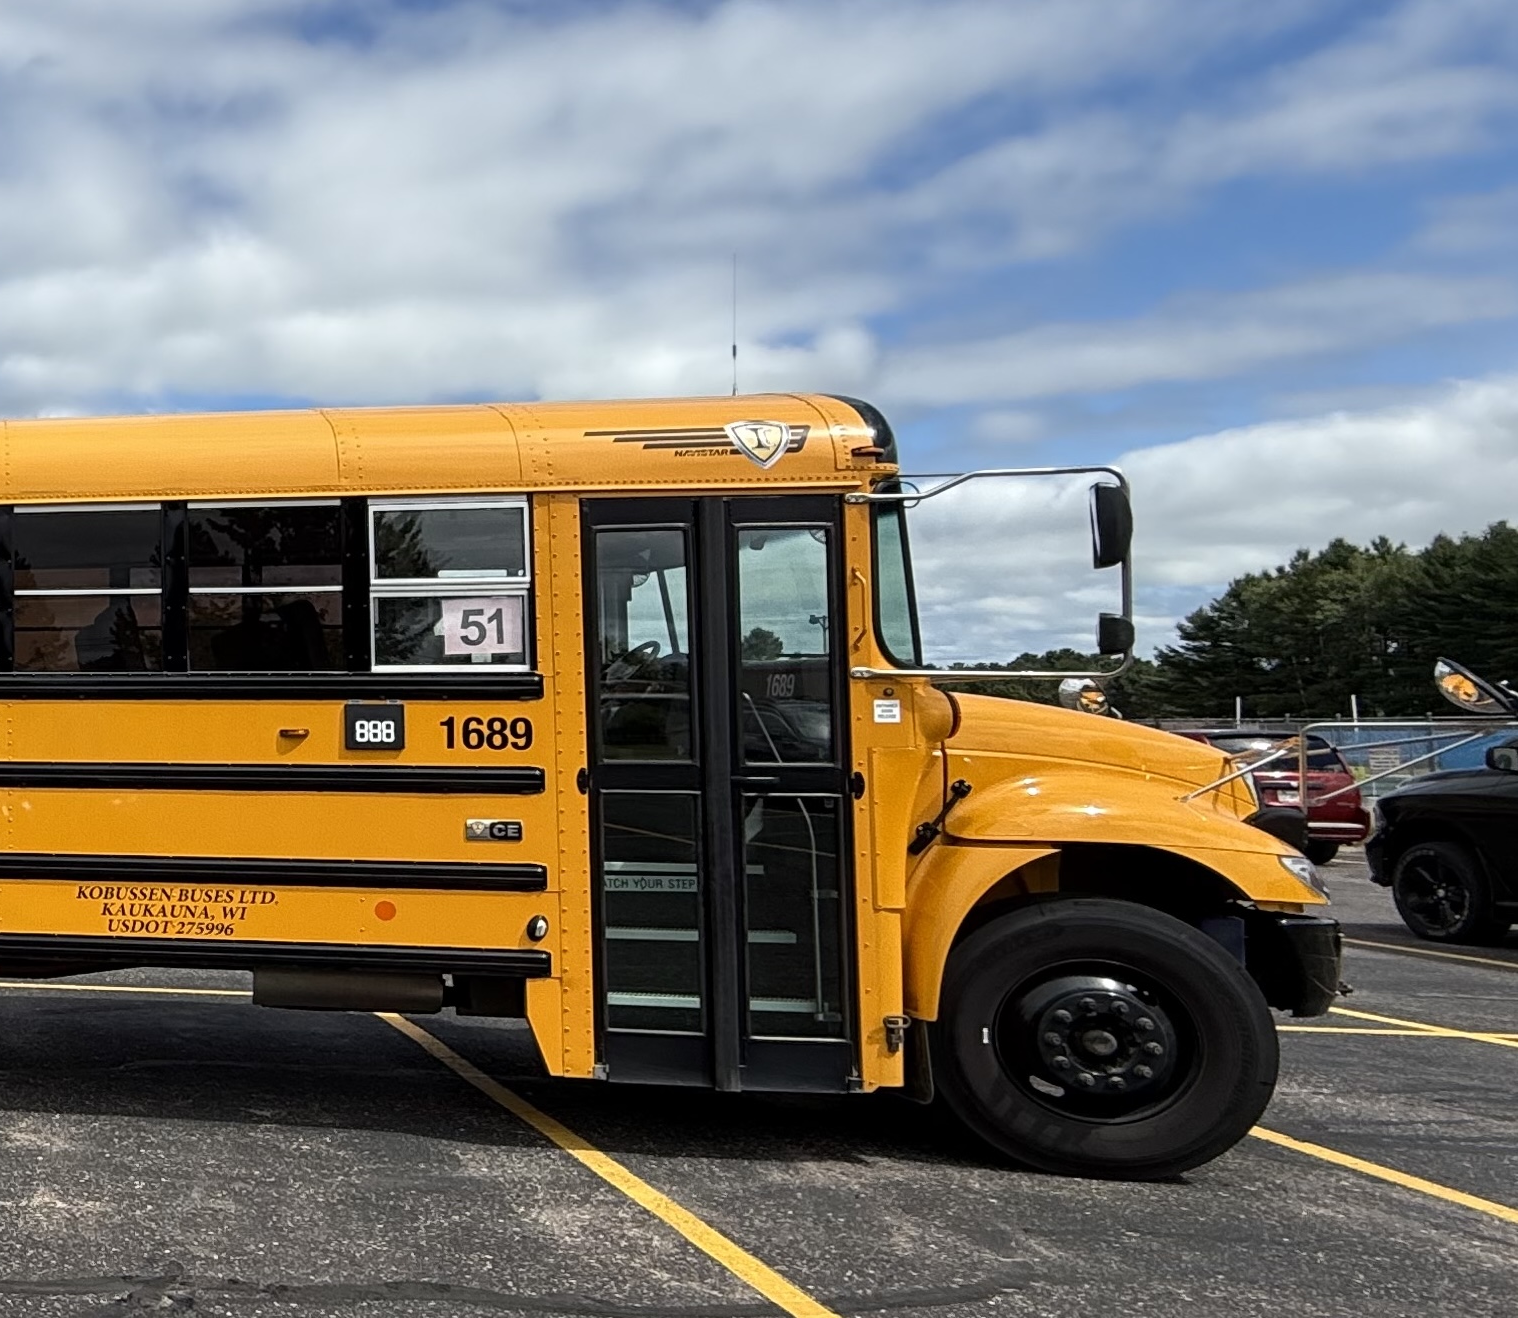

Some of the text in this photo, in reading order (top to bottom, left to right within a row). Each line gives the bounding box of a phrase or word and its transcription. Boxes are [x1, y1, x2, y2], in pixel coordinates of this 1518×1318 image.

[460, 607, 504, 647] 51
[766, 673, 796, 698] 1689
[355, 720, 396, 743] 888
[439, 716, 533, 751] 1689
[492, 824, 520, 838] CE
[633, 877, 663, 890] YOUR
[667, 878, 696, 890] STEP
[76, 885, 172, 902] KOBUSSEN
[177, 888, 235, 904] BUSES
[101, 902, 248, 921] KAUKAUNA, WI
[108, 918, 235, 936] USDOT 275996
